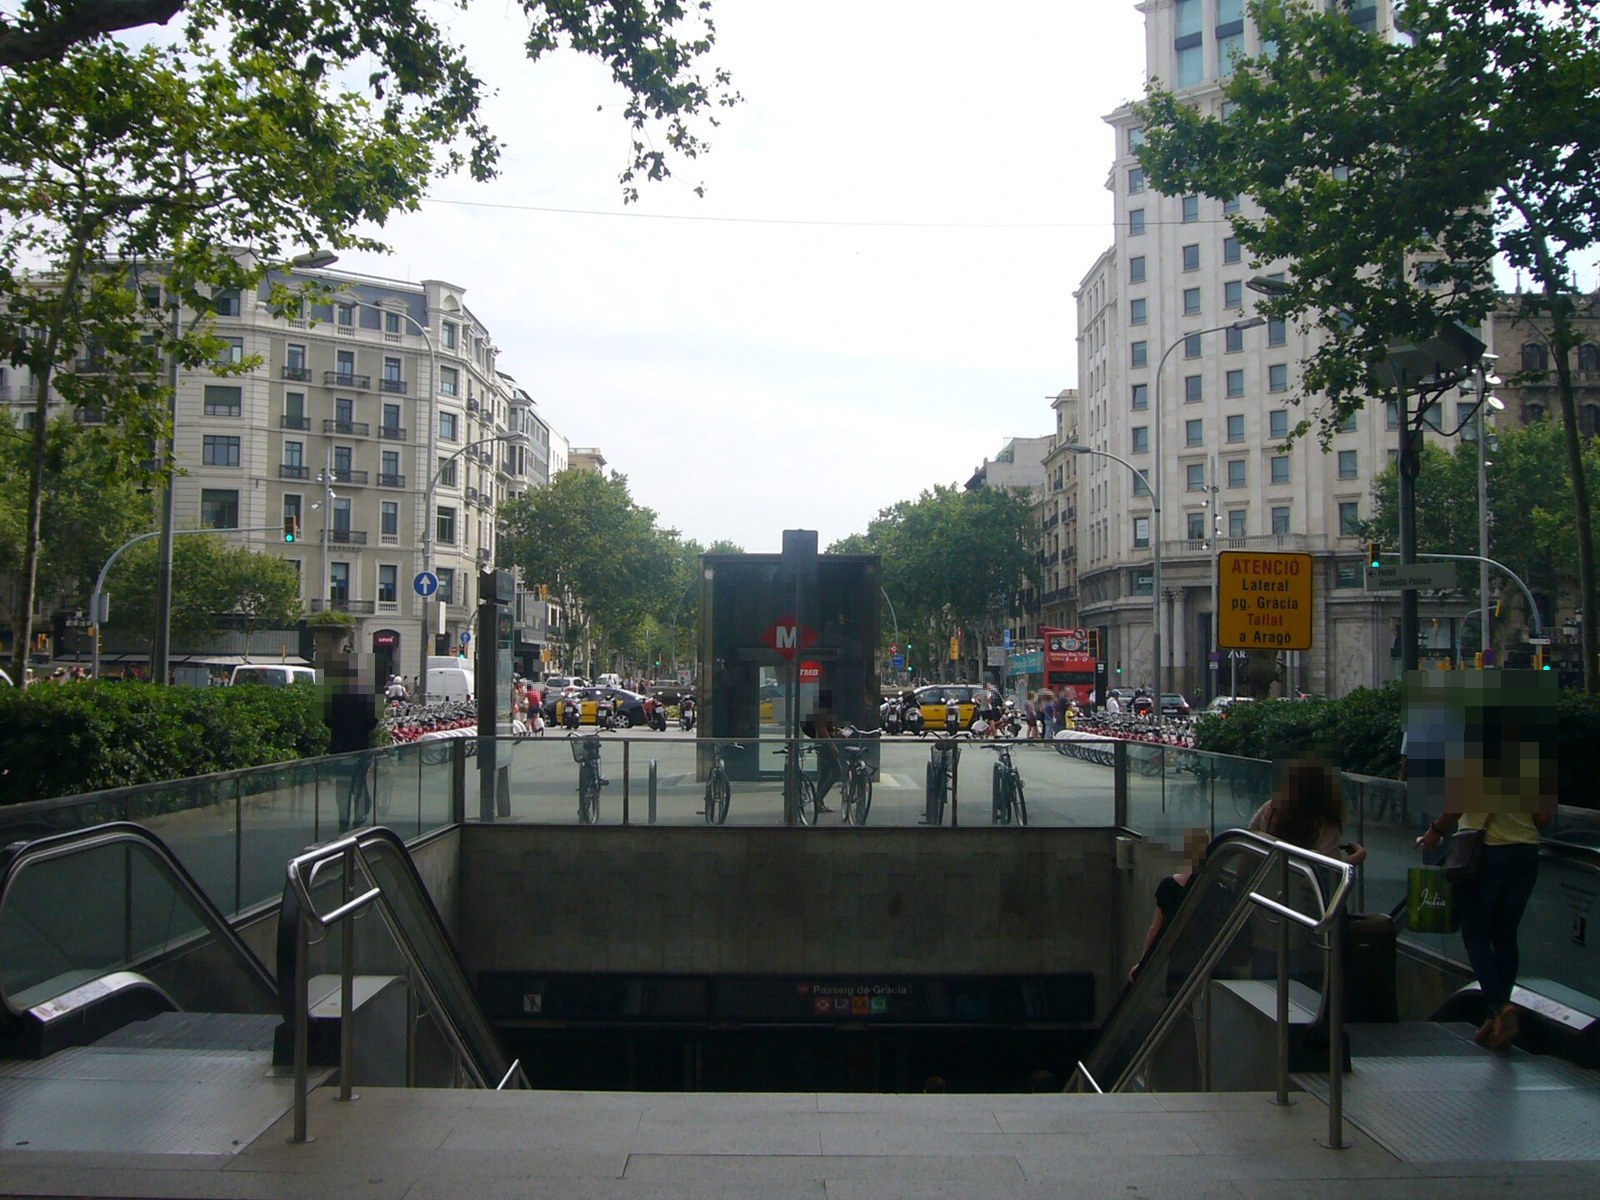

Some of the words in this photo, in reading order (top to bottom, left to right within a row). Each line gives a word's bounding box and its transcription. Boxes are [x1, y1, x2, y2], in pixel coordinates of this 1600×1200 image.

[1232, 557, 1300, 576] ATENCIÓ
[1242, 578, 1289, 592] Lateral
[1231, 598, 1250, 611] pg.
[1257, 596, 1299, 610] Gràcia
[1247, 613, 1284, 627] Tallat
[776, 626, 797, 648] M
[1239, 632, 1246, 642] a
[1253, 630, 1291, 645] Aragó
[799, 668, 819, 677] TMB
[812, 985, 854, 996] Passeig
[856, 984, 870, 995] de
